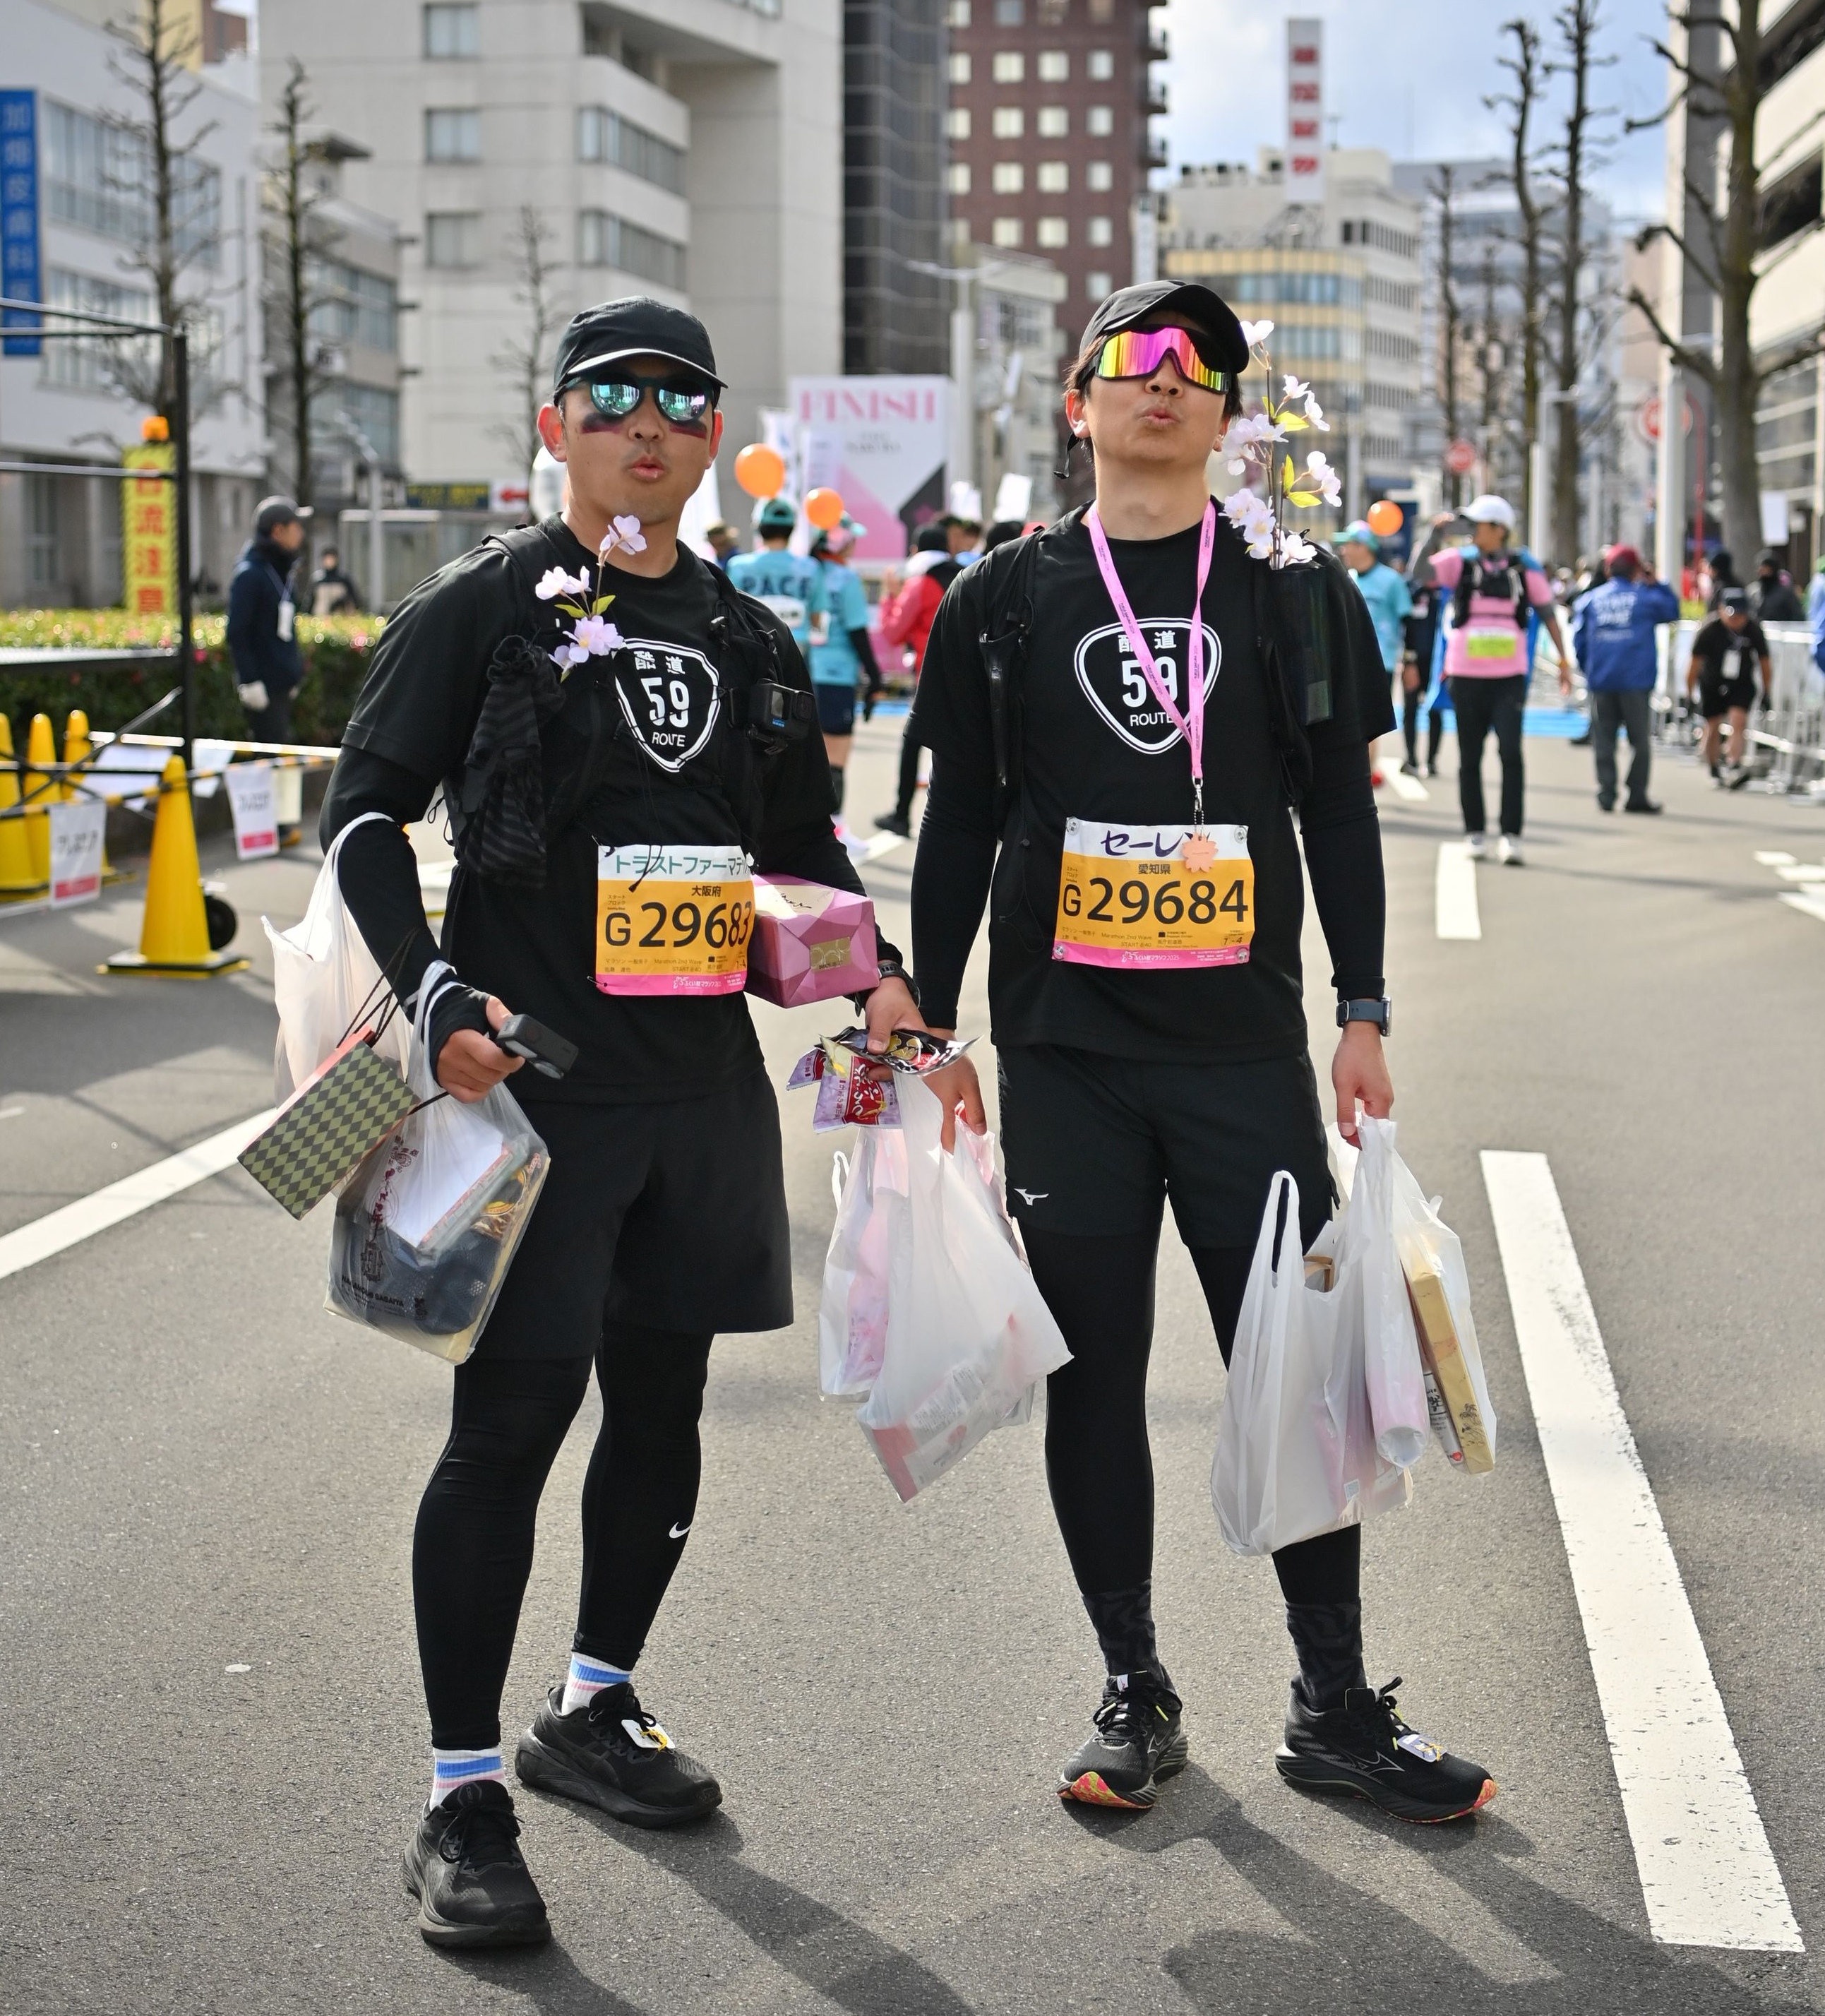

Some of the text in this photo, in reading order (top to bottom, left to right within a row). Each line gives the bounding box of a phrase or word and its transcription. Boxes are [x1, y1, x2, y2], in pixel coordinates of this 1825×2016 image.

[634, 650, 686, 675] 酷道
[1121, 657, 1178, 708] 59
[640, 676, 689, 728] 59
[1130, 712, 1175, 727] ROUTE
[652, 732, 686, 747] ROUTE
[1138, 864, 1171, 875] 愛知県
[691, 885, 722, 897] 大阪府
[1063, 877, 1248, 925] G 29684
[605, 901, 752, 949] G 29683
